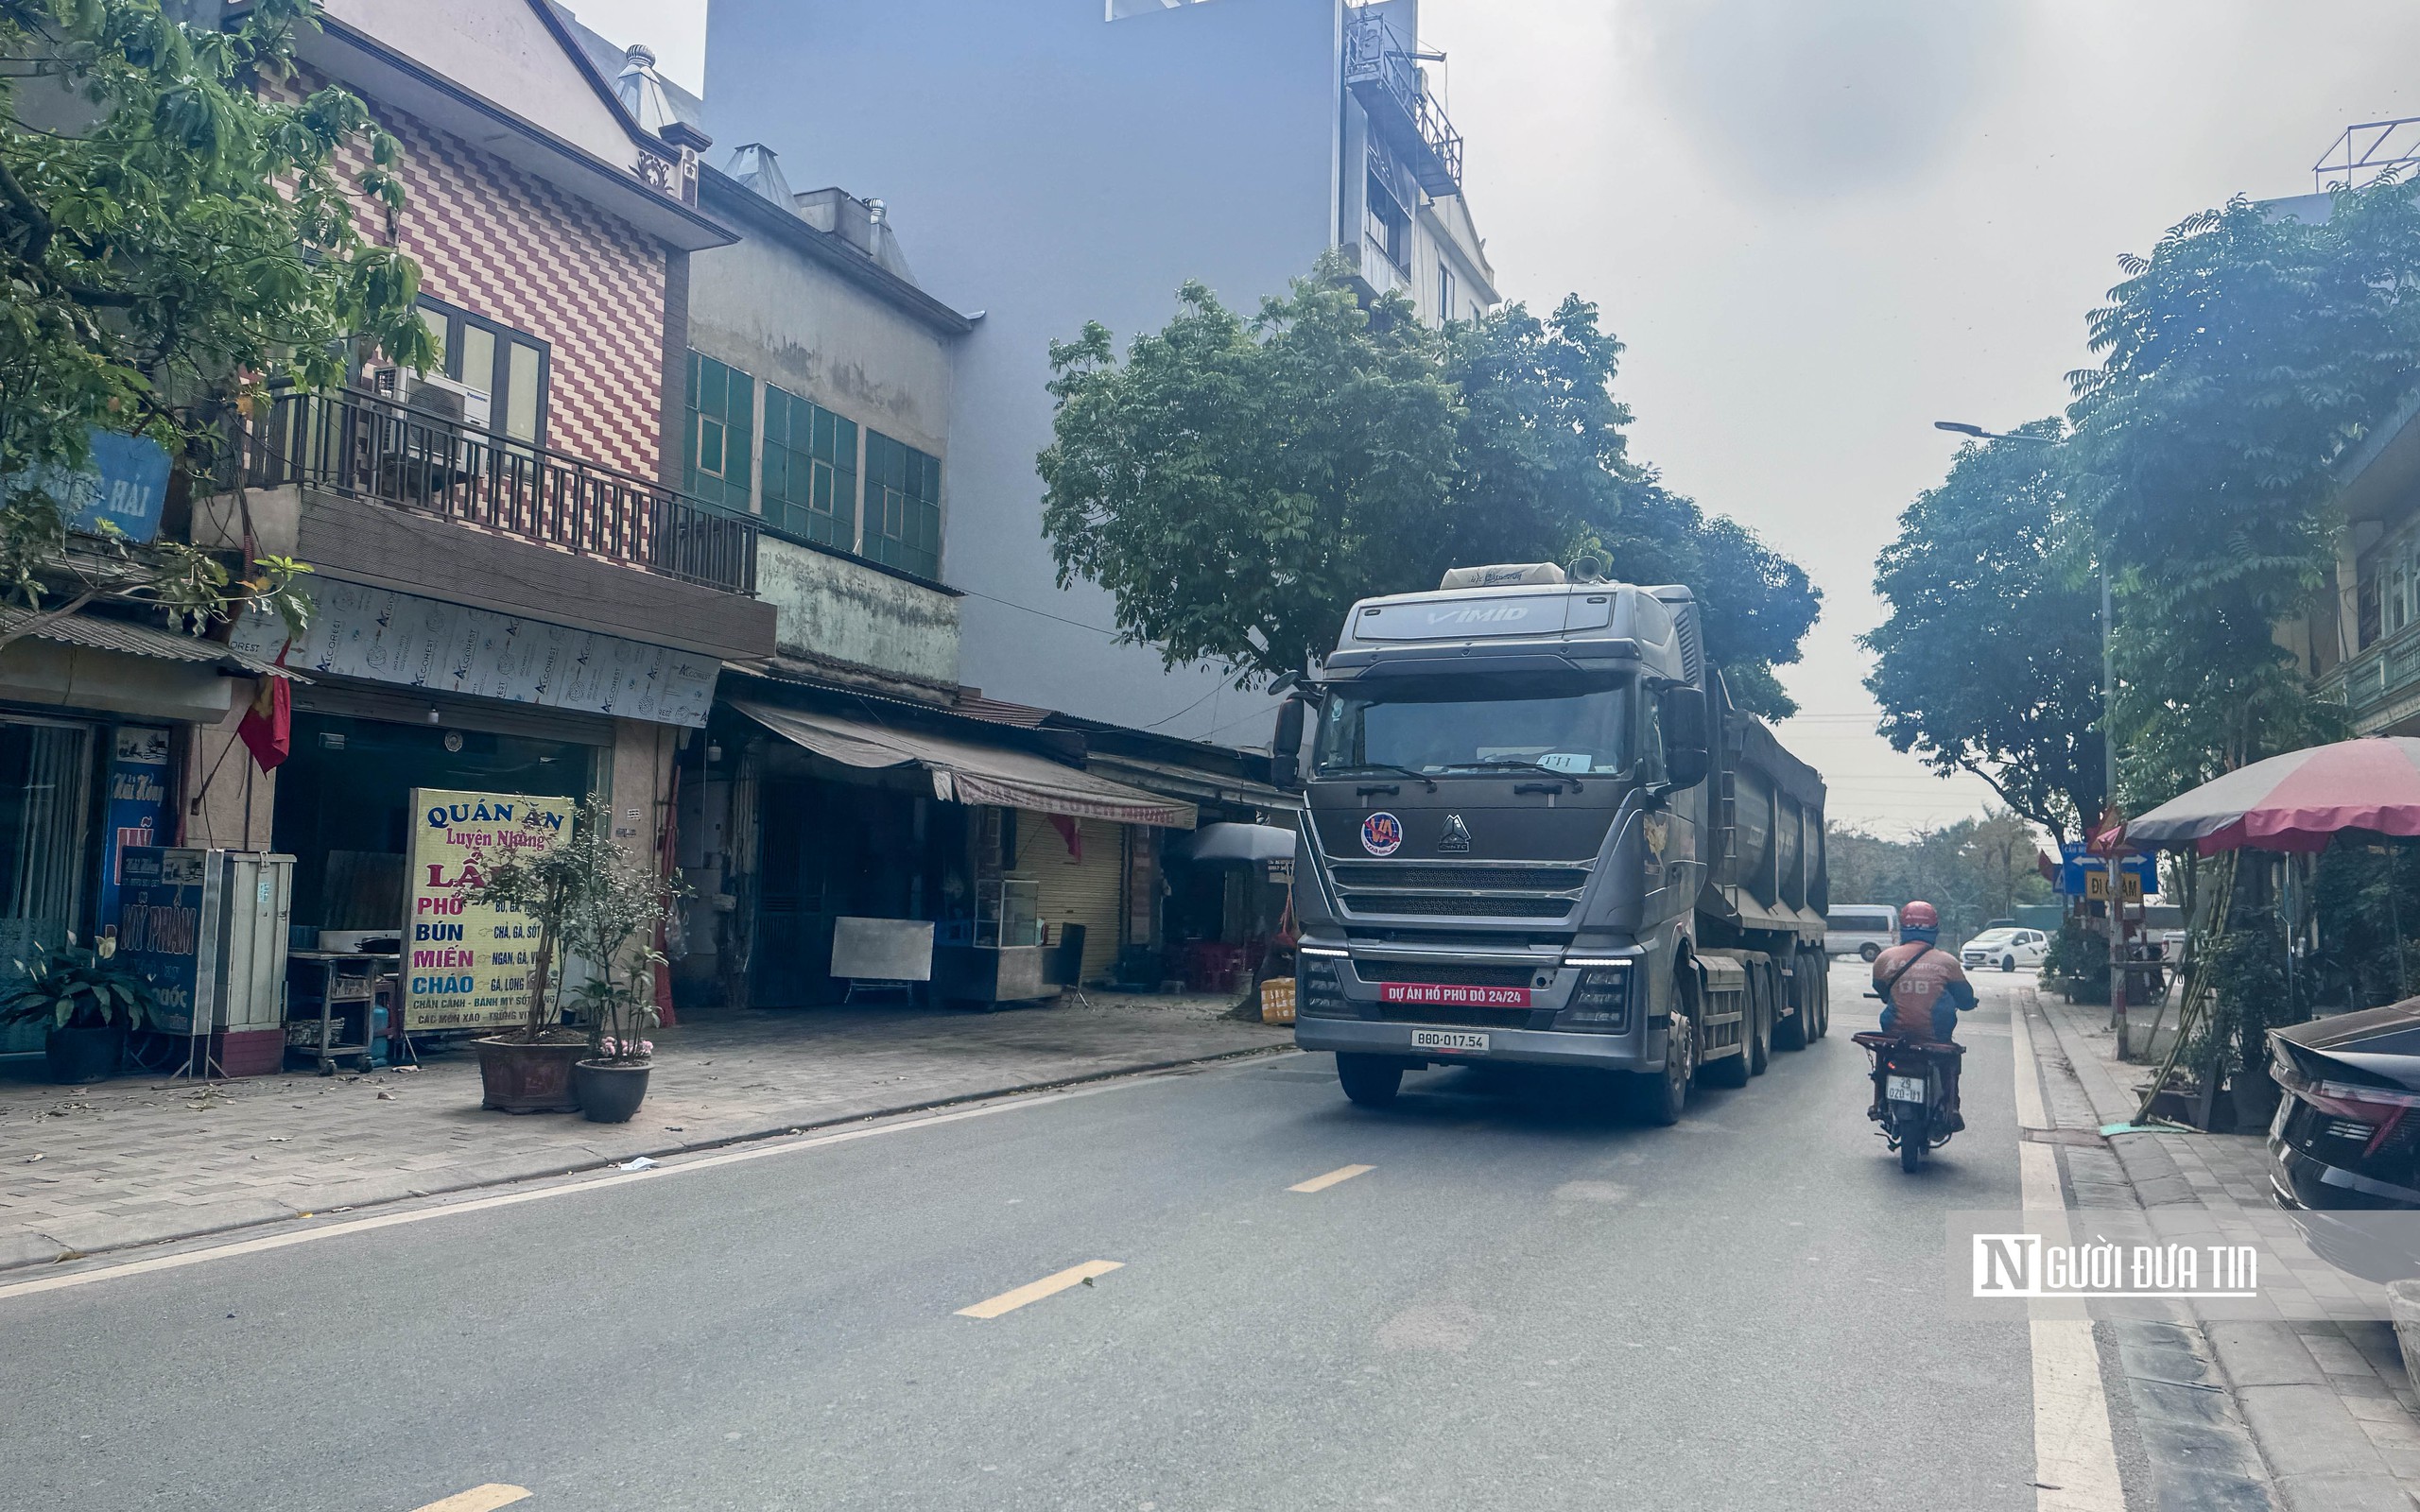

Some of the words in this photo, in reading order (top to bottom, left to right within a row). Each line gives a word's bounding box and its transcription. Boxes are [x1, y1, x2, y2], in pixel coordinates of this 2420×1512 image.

[427, 799, 514, 829] QUÁN
[416, 920, 463, 941] BÚN
[411, 972, 474, 994] CHÁO
[1489, 990, 1521, 1004] 24/24
